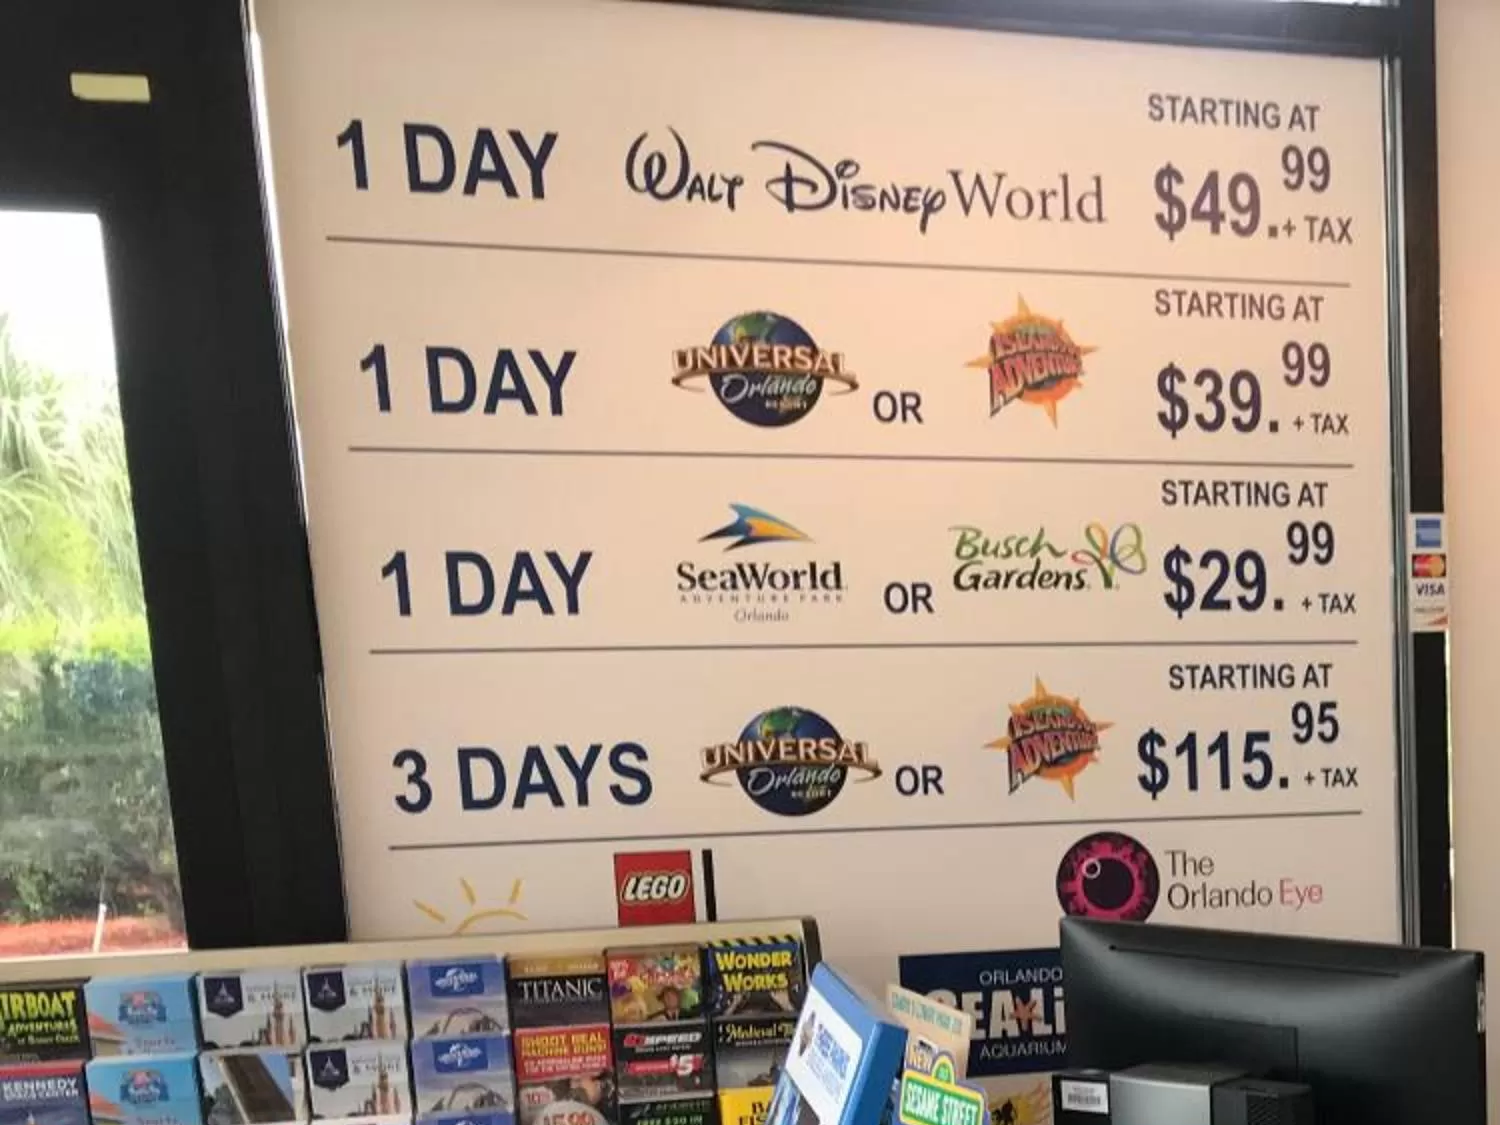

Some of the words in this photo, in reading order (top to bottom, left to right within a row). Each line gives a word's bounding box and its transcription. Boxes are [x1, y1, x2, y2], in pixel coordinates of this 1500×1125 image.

[1148, 94, 1281, 129] STARTING
[1287, 105, 1320, 132] AT
[336, 119, 369, 190] 1
[403, 123, 559, 200] DAY
[947, 169, 1107, 224] World
[1281, 145, 1331, 193] 99
[1304, 217, 1353, 244] TAX
[1154, 289, 1285, 321] STARTING
[1292, 296, 1325, 321] AT
[671, 342, 849, 376] UNIVERSAL
[361, 344, 391, 413] 1
[426, 346, 577, 417] DAY
[720, 371, 818, 404] Orlando
[1281, 341, 1331, 387] 99
[1311, 414, 1349, 435] TAX
[872, 390, 924, 425] OR
[1161, 481, 1291, 508] STARTING
[1297, 482, 1329, 508] AT
[948, 525, 1070, 561] Busch
[676, 561, 844, 592] SeaWorld
[952, 555, 1087, 593] Gardens
[1286, 520, 1335, 566] 99
[1318, 593, 1357, 615] TAX
[381, 551, 412, 618] 1
[445, 551, 593, 616] DAY
[883, 582, 935, 615] OR
[1415, 583, 1446, 597] VISA
[733, 608, 790, 623] Orlando
[1168, 664, 1296, 690] STARTING
[1302, 664, 1333, 690] AT
[700, 738, 871, 768] UNIVERSAL
[1291, 701, 1340, 745] 95
[1320, 767, 1359, 789] TAX
[393, 749, 433, 814] 3
[457, 742, 653, 812] DAYS
[747, 763, 841, 795] Orlando
[895, 765, 945, 797] OR
[1165, 849, 1215, 877] The
[621, 868, 689, 902] LEGO
[1167, 880, 1274, 910] Orlando
[1279, 879, 1324, 911] Eye
[716, 951, 792, 971] WONDER
[979, 966, 1064, 987] ORLANDO
[518, 978, 602, 1003] TITANIC
[722, 971, 789, 992] WORKS
[2, 1077, 78, 1091] KENNEDY
[904, 1081, 941, 1124] SESAME
